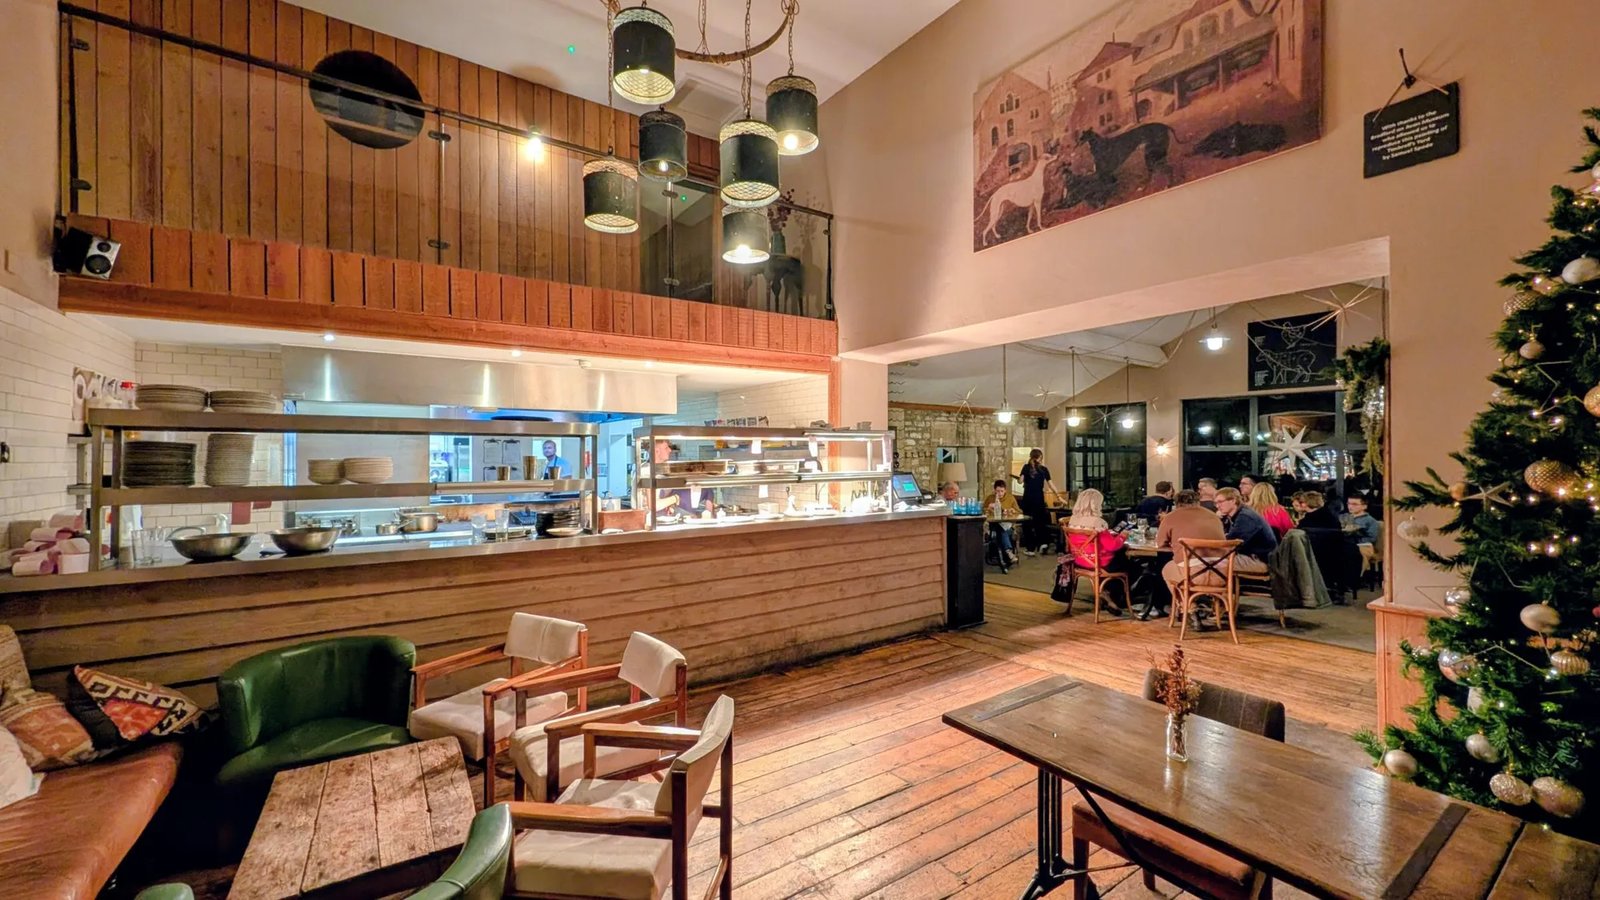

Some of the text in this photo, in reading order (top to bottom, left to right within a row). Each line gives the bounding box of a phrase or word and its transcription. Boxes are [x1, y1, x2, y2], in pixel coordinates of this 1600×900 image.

[1397, 117, 1417, 126] thanks
[1422, 113, 1449, 124] Museum
[1396, 128, 1419, 138] allowed
[1414, 128, 1439, 139] painting
[1391, 148, 1413, 158] Samuel
